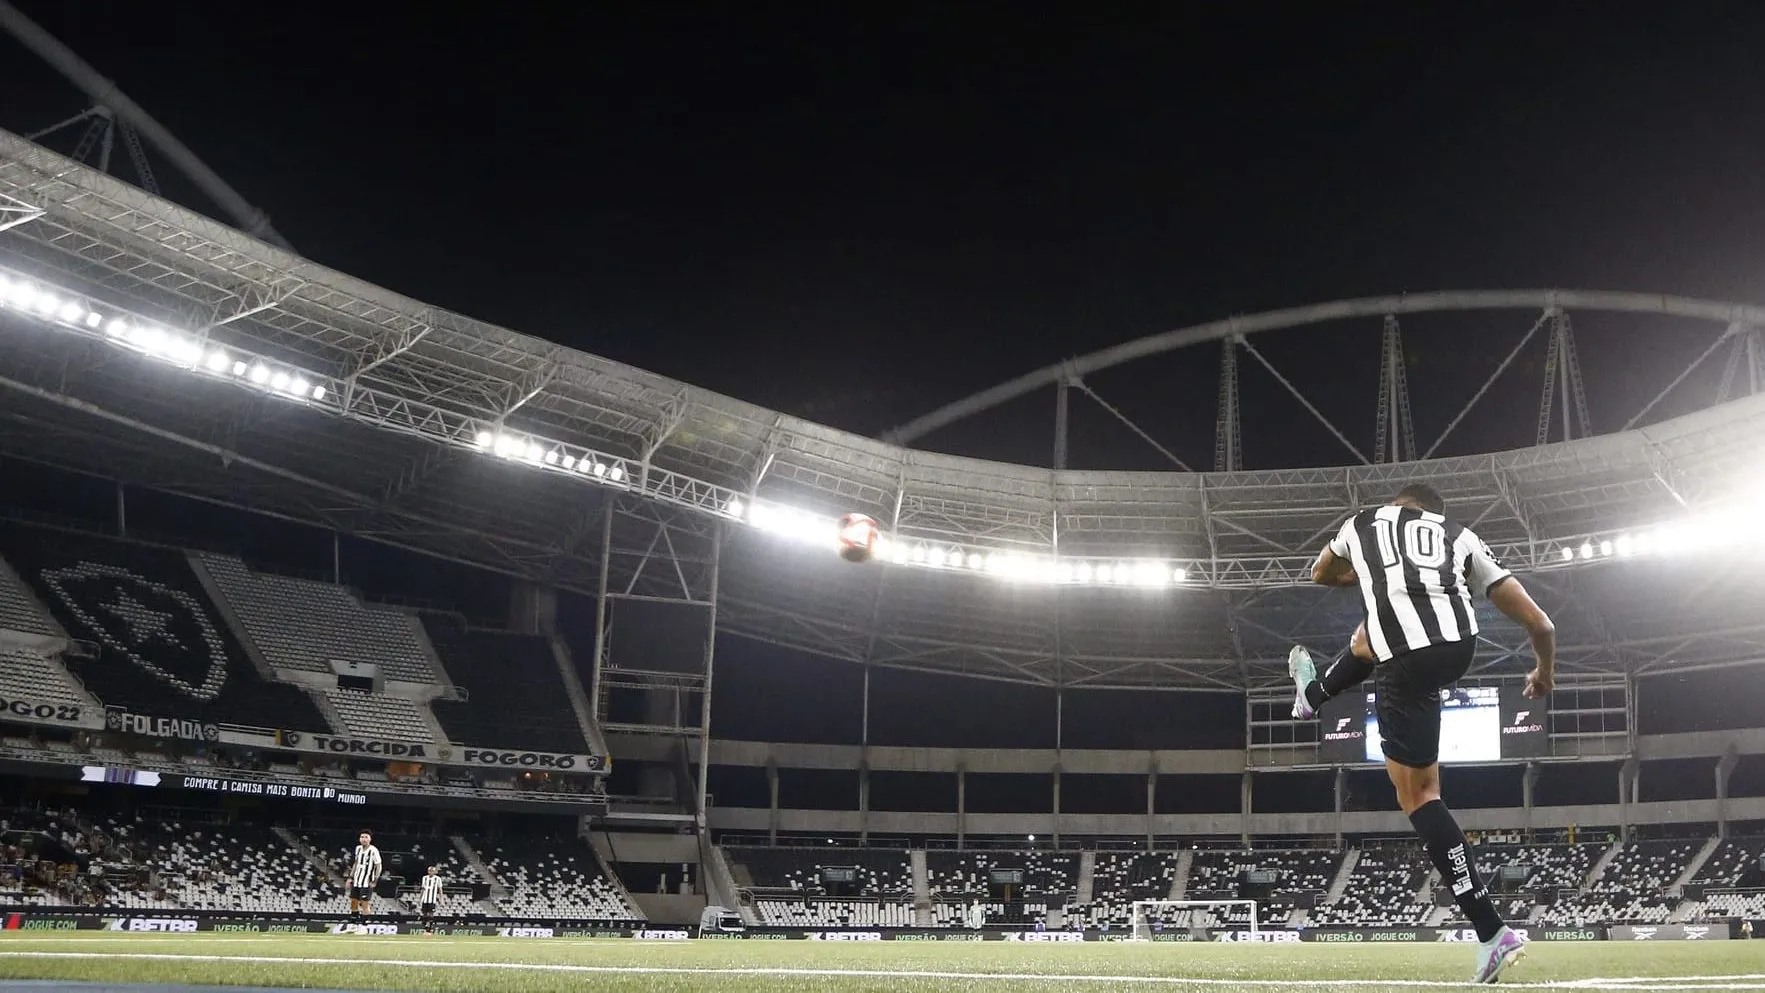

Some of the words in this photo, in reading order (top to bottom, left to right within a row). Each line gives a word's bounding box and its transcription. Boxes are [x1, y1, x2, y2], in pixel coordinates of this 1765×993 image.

[1371, 518, 1447, 570] 10
[121, 713, 204, 741] FOLGADA
[313, 735, 426, 757] TORCIDA
[464, 750, 576, 769] FOGORÓ
[184, 777, 218, 790] COMPRE
[221, 781, 228, 790] A
[231, 782, 262, 794] CAMISA
[266, 784, 287, 796] MAIS
[291, 786, 321, 798] BONITA
[338, 794, 366, 804] MUNDO
[24, 920, 55, 930] JOGUE
[56, 920, 77, 930] COM
[1316, 931, 1363, 941] IVERSÃO
[1371, 932, 1396, 941] JOGUE
[1397, 932, 1416, 941] COM
[1436, 929, 1459, 942] 7K
[1545, 928, 1595, 940] IVERSÃO
